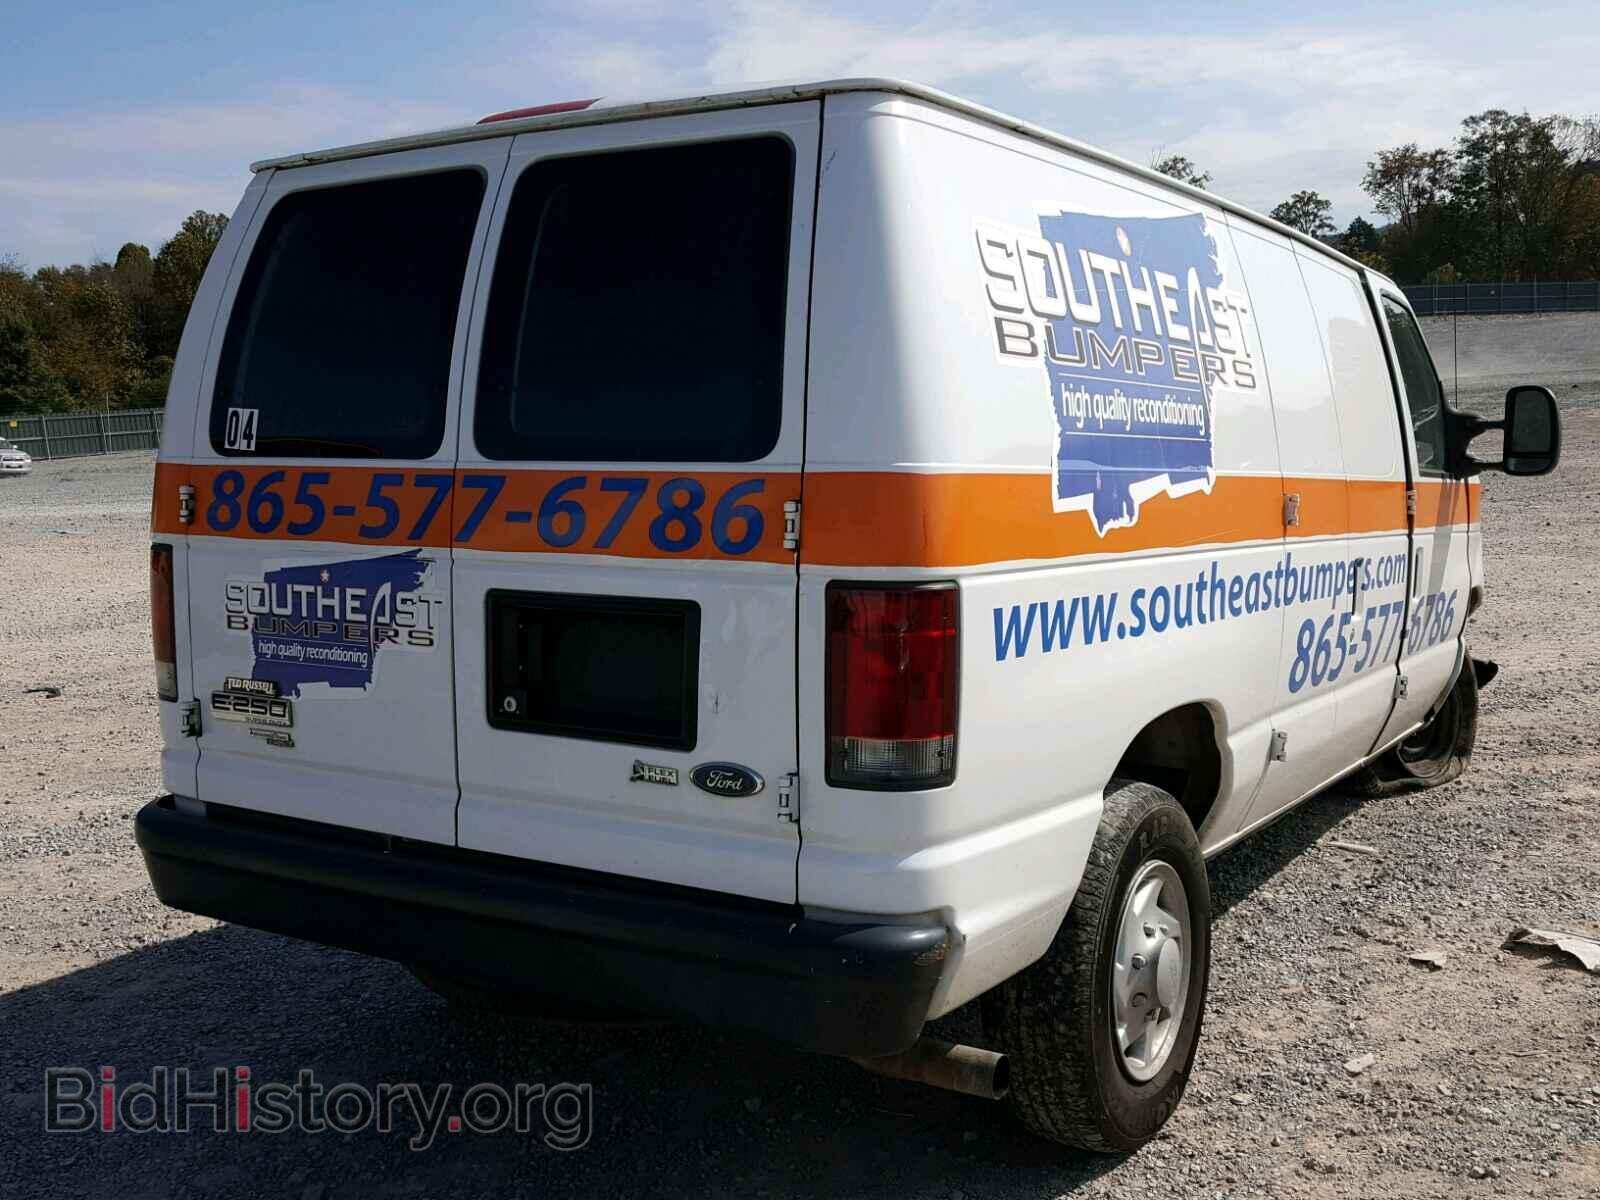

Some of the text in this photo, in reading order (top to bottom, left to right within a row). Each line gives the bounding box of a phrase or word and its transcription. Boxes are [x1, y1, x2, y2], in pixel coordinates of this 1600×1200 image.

[975, 228, 1251, 359] SOUTHEAST
[994, 316, 1256, 389] BUMPERS
[227, 409, 255, 449] 04
[1061, 383, 1205, 436] high quality reconditioning
[205, 470, 766, 555] 865-577-6786
[225, 582, 443, 630] SOUTHEAST
[227, 615, 435, 647] BUMPERS
[993, 552, 1406, 661] www.southeastbumpers.com
[258, 640, 368, 668] high quality reconditioning
[706, 769, 743, 791] Ford
